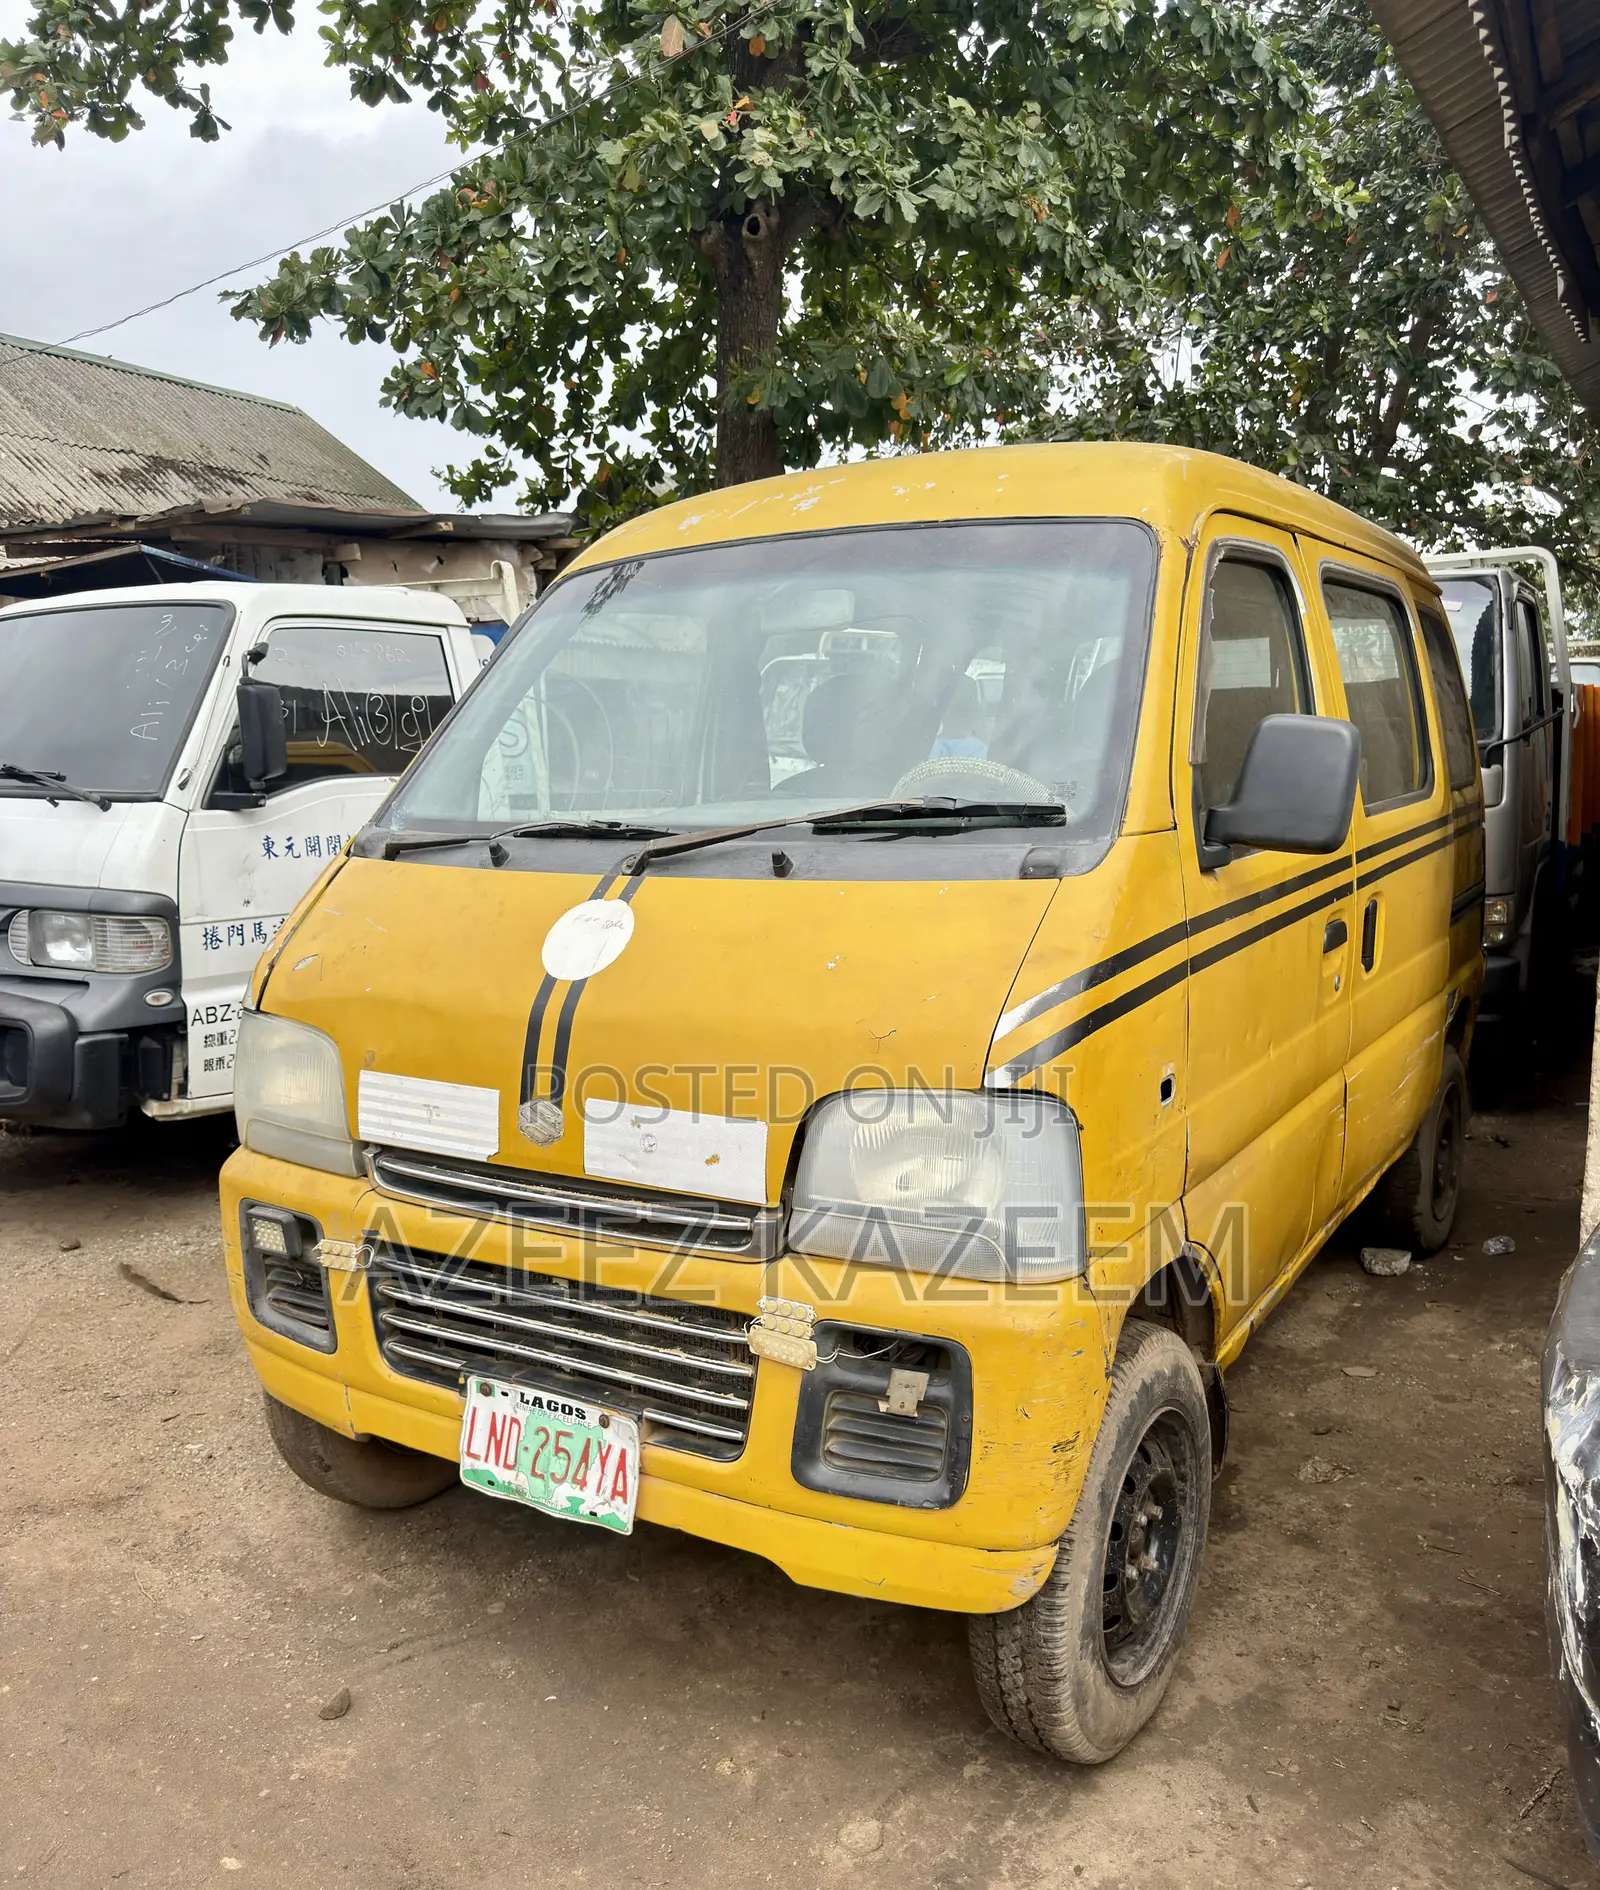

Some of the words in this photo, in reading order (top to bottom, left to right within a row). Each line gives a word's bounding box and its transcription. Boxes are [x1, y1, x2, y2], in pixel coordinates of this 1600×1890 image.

[261, 833, 350, 860] 東元開閉
[519, 1391, 587, 1420] LAGOS
[465, 1406, 629, 1505] LND-254YA
